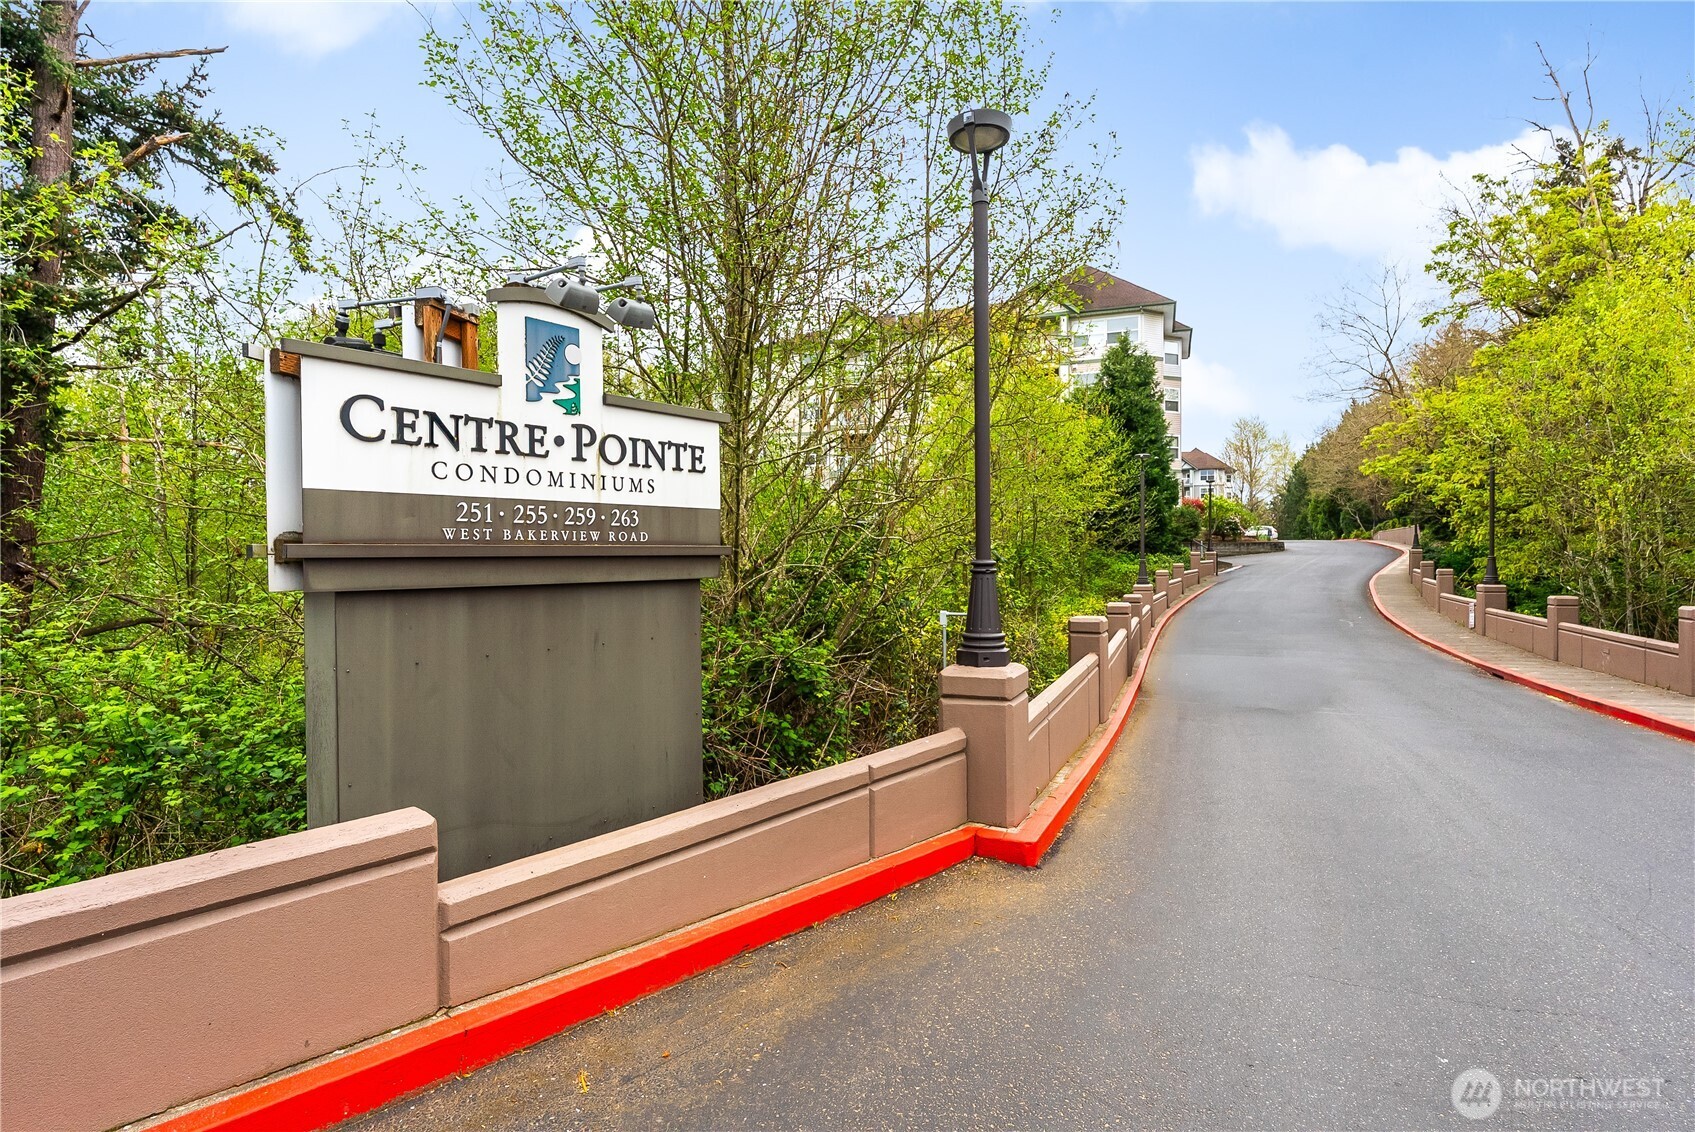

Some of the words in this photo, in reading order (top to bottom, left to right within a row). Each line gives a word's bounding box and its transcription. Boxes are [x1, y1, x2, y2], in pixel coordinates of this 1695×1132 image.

[571, 423, 707, 474] POINTE
[431, 461, 655, 494] CONDOMINIUMS
[456, 501, 493, 523] 251
[513, 504, 548, 525] 255
[564, 506, 596, 526] 259
[610, 508, 640, 527] 263
[442, 527, 493, 541] WEST
[503, 529, 601, 542] BAKERVIEW
[608, 531, 649, 543] ROAD
